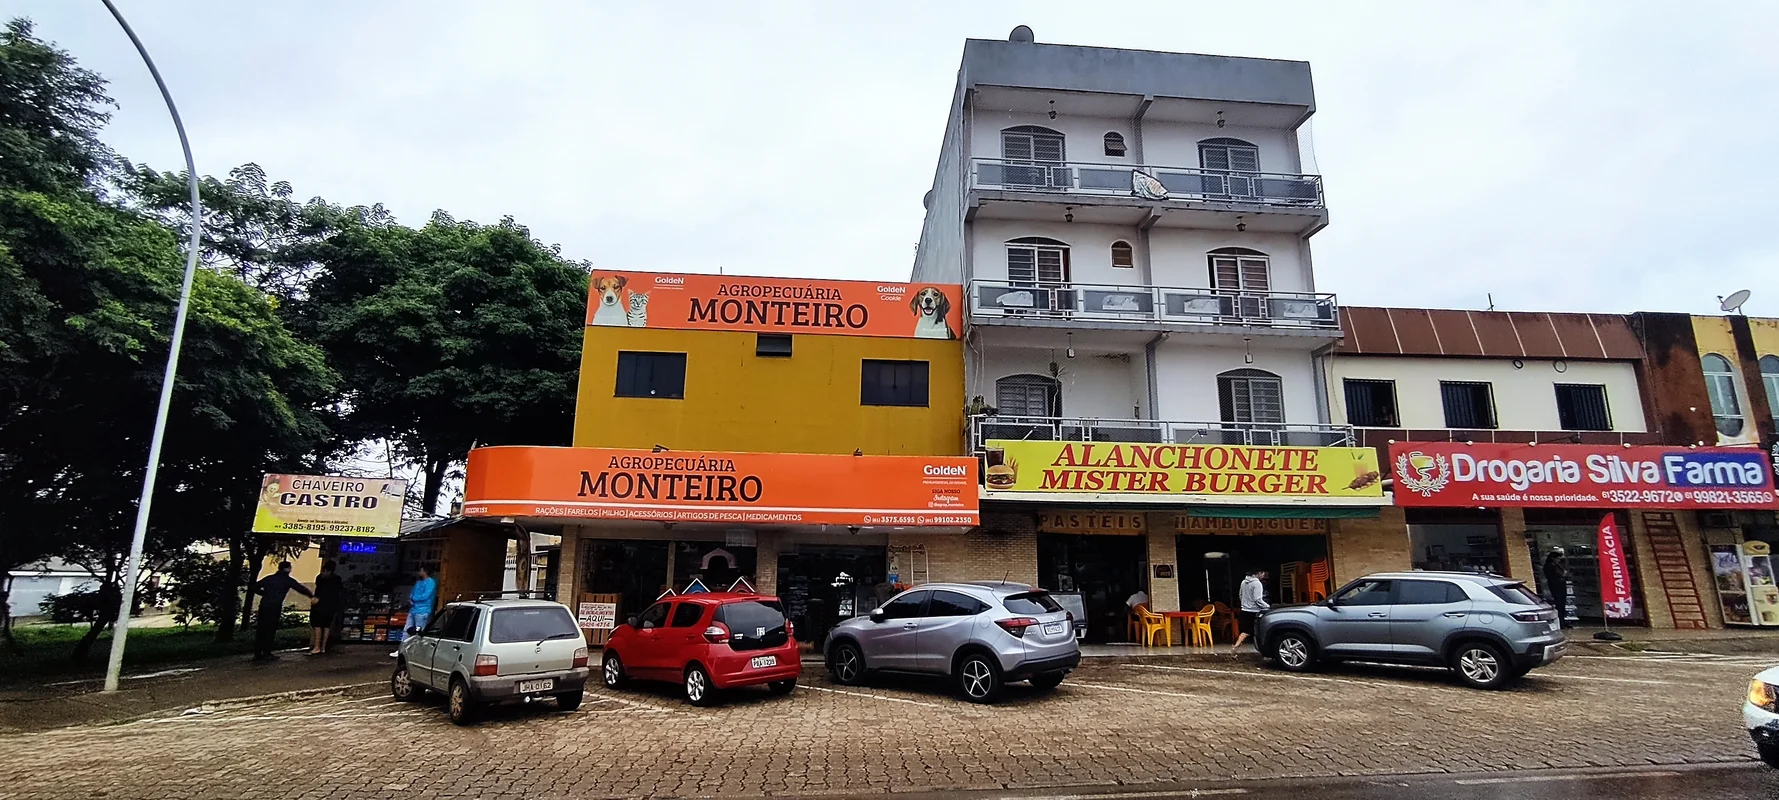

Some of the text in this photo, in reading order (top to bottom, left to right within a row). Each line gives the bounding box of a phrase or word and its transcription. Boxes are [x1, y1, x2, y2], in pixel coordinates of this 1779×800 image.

[717, 284, 842, 301] AGROPECUÁRIA
[877, 285, 906, 294] GoldeN
[687, 297, 868, 329] MONTEIRO
[608, 455, 736, 473] AGROPECUÁRIA
[1051, 443, 1319, 473] ALANCHONETE
[923, 464, 966, 475] GoldeN
[1451, 453, 1581, 491] Drogaria
[1586, 454, 1660, 484] Silva
[1664, 455, 1764, 486] Farma
[292, 479, 364, 493] CHAVEIRO
[577, 471, 763, 502] MONTEIRO
[1039, 469, 1329, 494] MISTER BURGER
[280, 492, 378, 509] CASTRO
[1471, 493, 1480, 501] A
[1496, 492, 1521, 501] saúde
[1522, 493, 1527, 501] é
[1529, 494, 1553, 502] nossa
[1554, 493, 1599, 503] prioridade.
[1610, 490, 1675, 503] 3522-9672
[1694, 491, 1764, 504] 99821-3565
[535, 506, 564, 516] RAÇÕES
[567, 508, 598, 516] FARELOS
[601, 509, 626, 517] MILHO
[629, 508, 673, 519] ACESSÓRIOS
[677, 511, 708, 519] ARTIGOS
[720, 512, 742, 520] PESCA
[745, 513, 802, 521] MEDICAMENTOS
[1174, 516, 1326, 530] HAMBURGUER
[1602, 525, 1626, 595] FARMÁCIA
